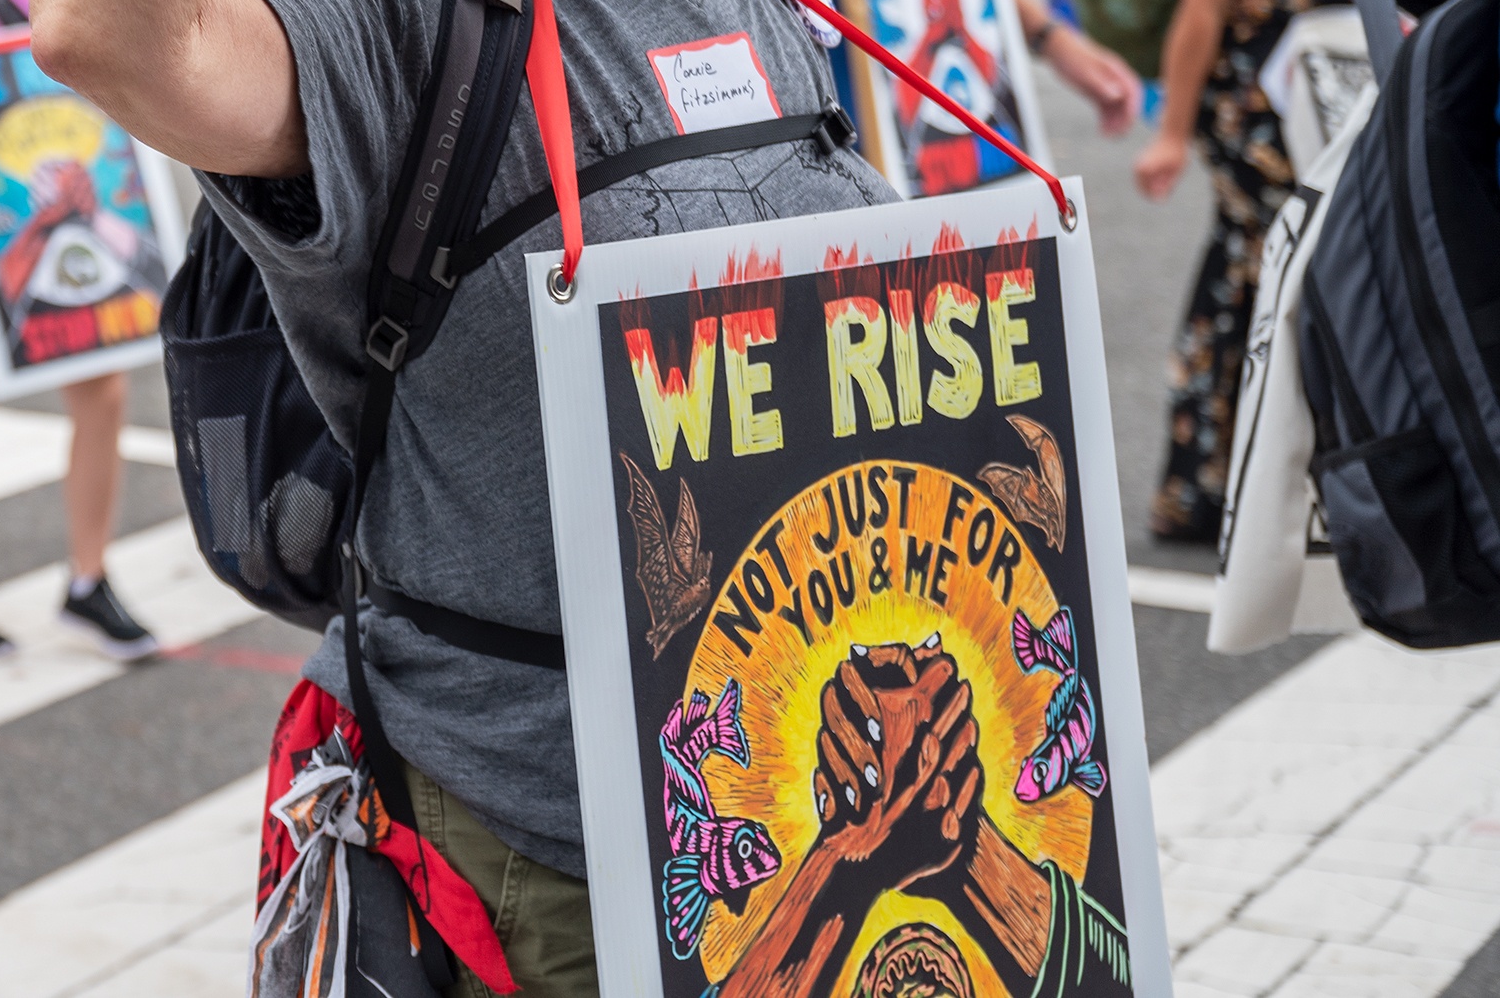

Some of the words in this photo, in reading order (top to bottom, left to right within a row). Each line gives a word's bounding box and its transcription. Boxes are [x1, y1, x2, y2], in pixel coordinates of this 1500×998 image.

[624, 307, 785, 472] WE
[824, 267, 1045, 438] RISE
[712, 517, 796, 657] NOT
[811, 465, 918, 555] JUST
[942, 486, 1022, 605] FOR
[778, 549, 856, 648] YOU
[868, 536, 894, 595] &
[902, 535, 961, 605] ME
